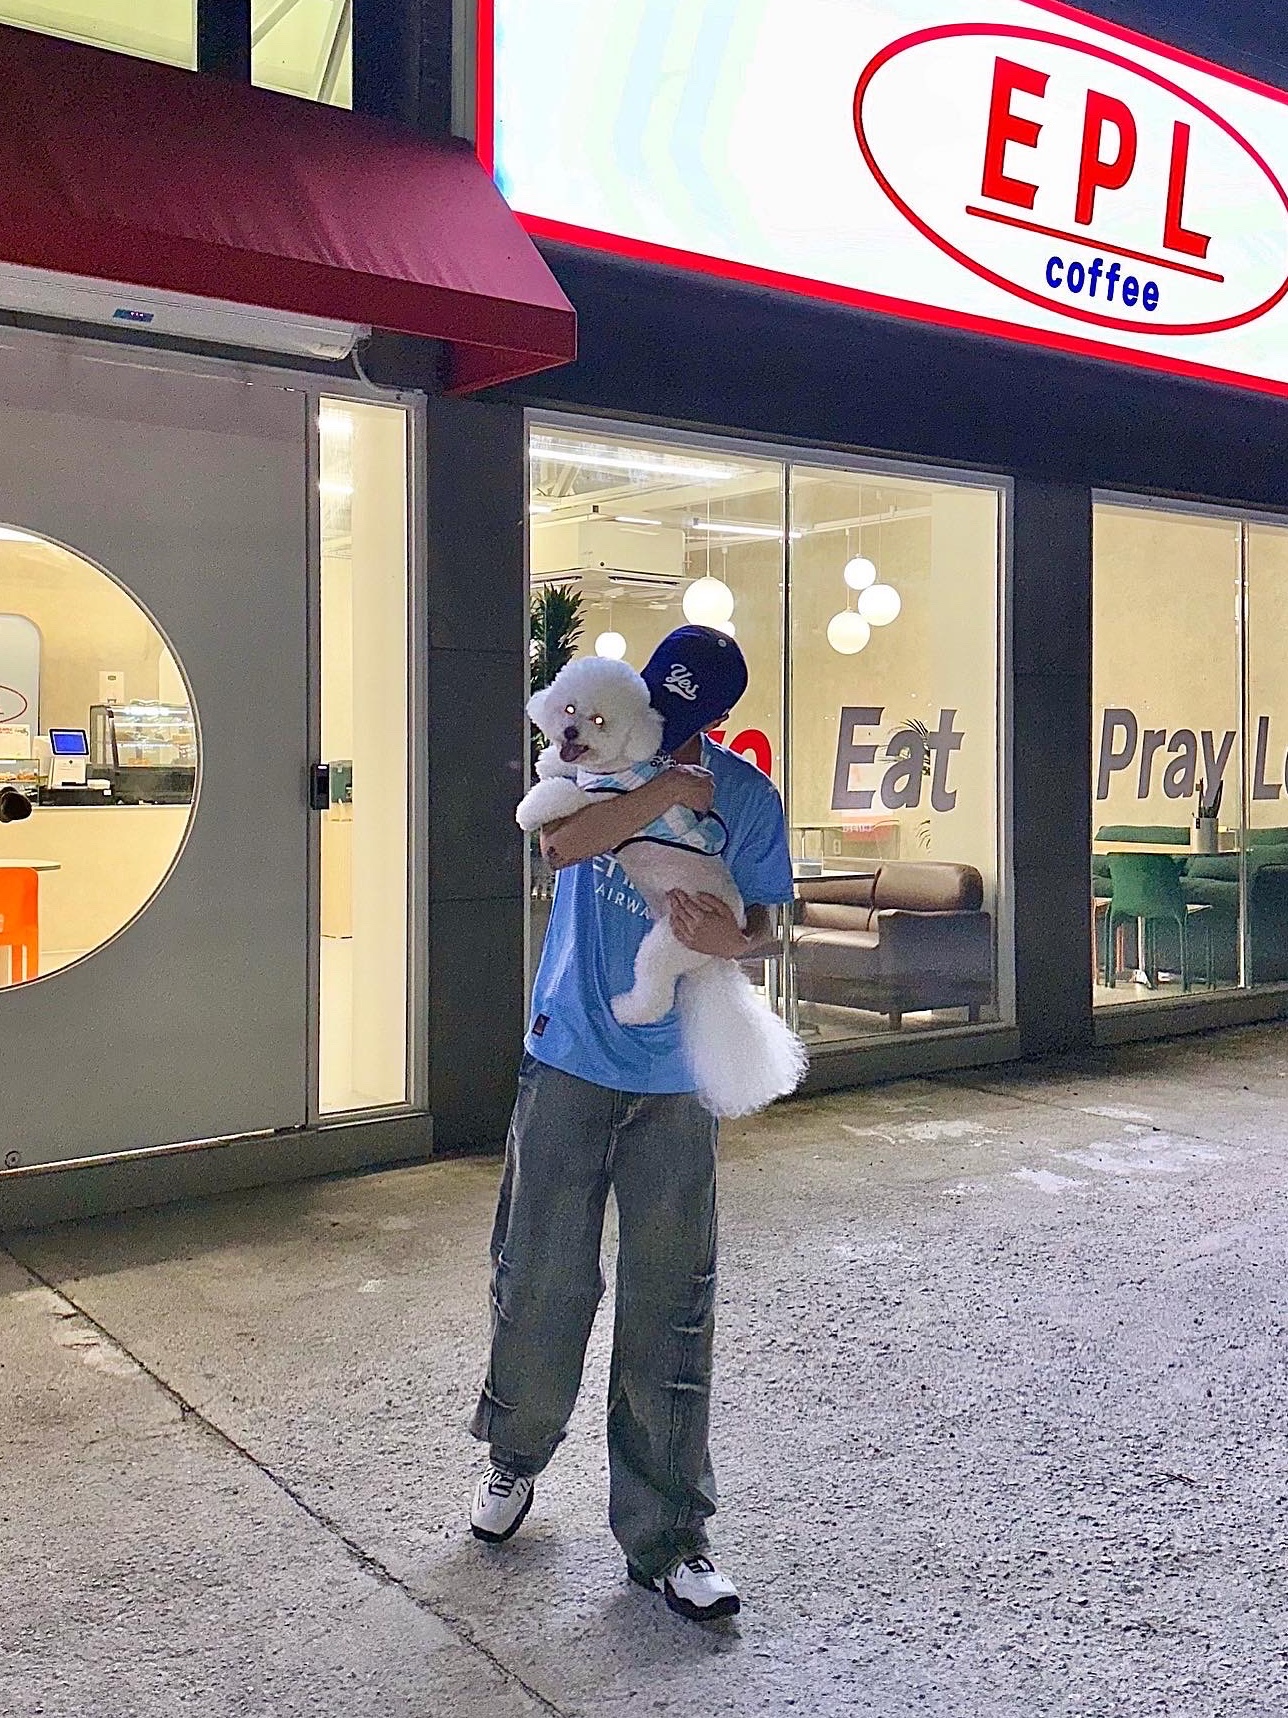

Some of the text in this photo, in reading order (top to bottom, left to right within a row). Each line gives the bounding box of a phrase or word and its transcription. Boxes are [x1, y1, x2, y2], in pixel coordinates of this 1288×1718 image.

[981, 56, 1211, 259] EPL
[1045, 256, 1159, 312] coffee
[665, 663, 699, 700] Yes
[831, 706, 965, 813] Eat
[1096, 708, 1237, 807] Pray
[1252, 715, 1288, 801] L
